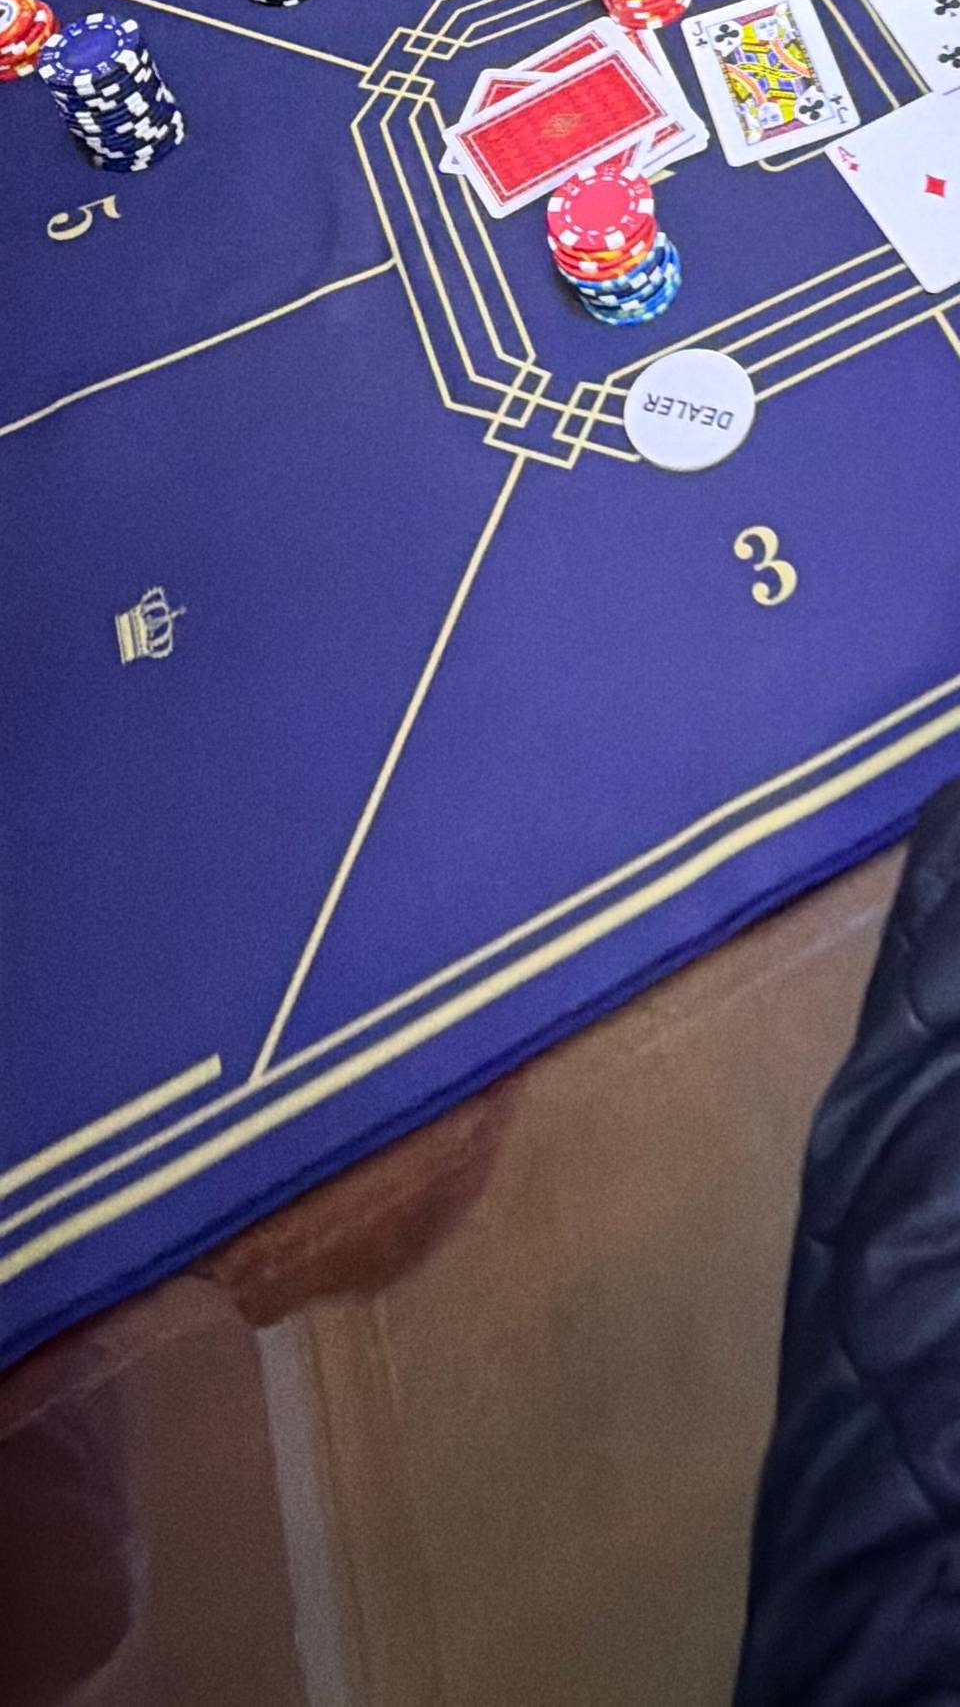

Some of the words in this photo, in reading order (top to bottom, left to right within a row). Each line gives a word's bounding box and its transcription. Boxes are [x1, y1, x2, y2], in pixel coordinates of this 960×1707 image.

[692, 21, 704, 37] J
[836, 107, 849, 125] J
[837, 145, 855, 163] A
[46, 194, 121, 242] 5
[643, 392, 735, 431] DEALER
[733, 525, 798, 606] 3
